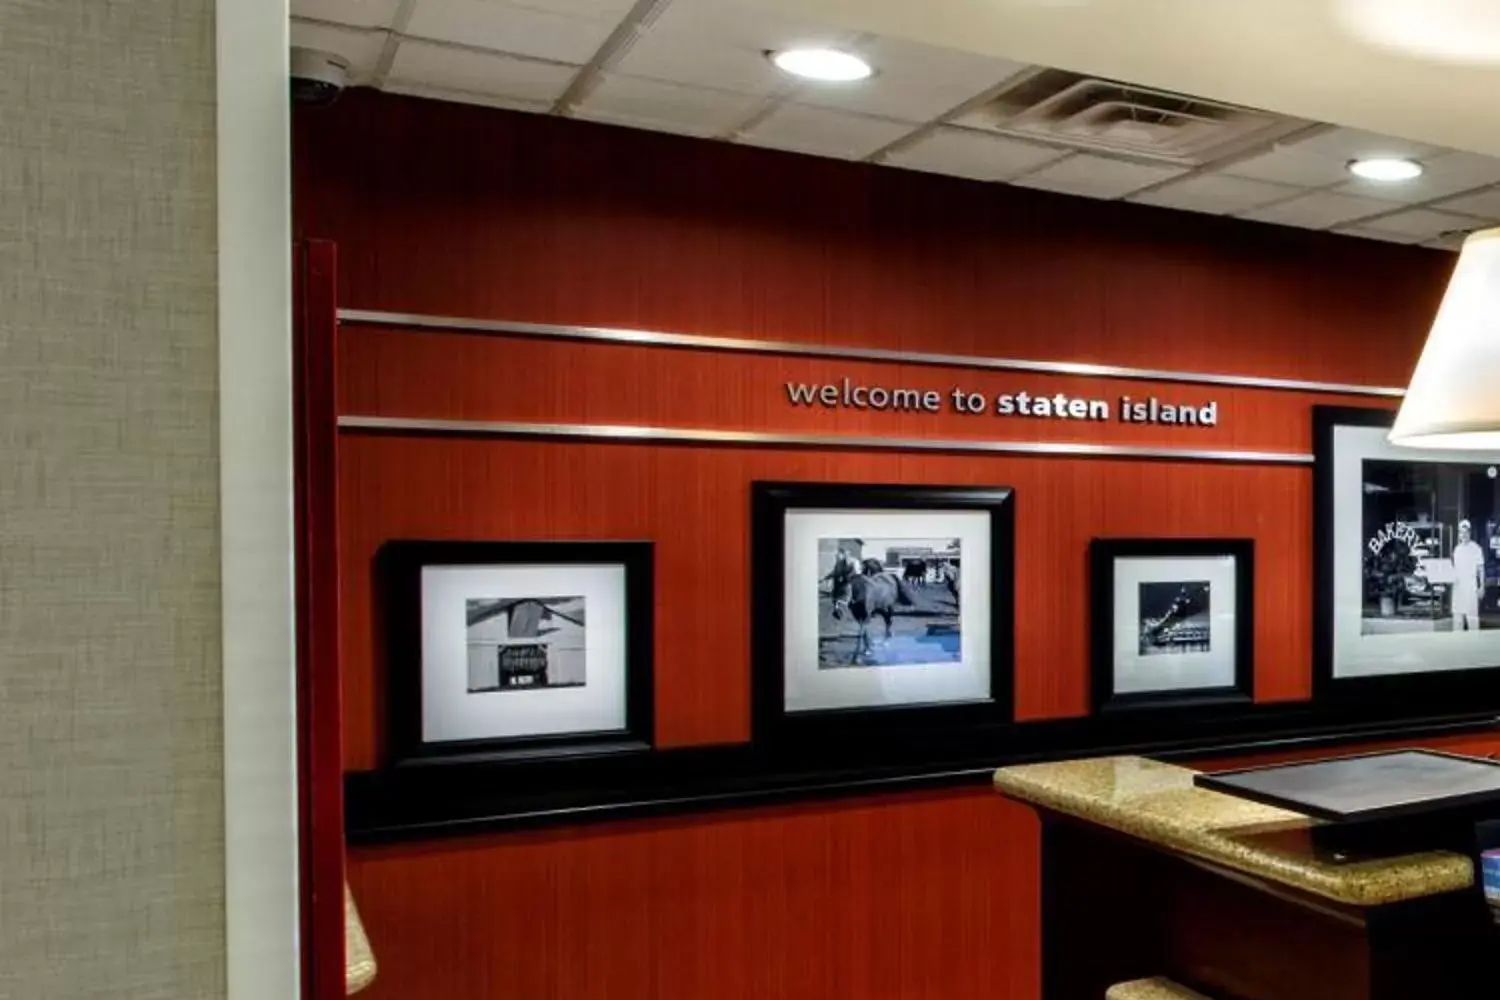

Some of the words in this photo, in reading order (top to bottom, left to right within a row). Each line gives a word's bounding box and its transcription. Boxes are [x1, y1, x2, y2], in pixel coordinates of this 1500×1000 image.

[787, 377, 941, 411] welcome
[954, 386, 986, 413] to
[998, 392, 1109, 420] staten
[1122, 396, 1218, 425] island
[1368, 521, 1425, 556] BAKERY
